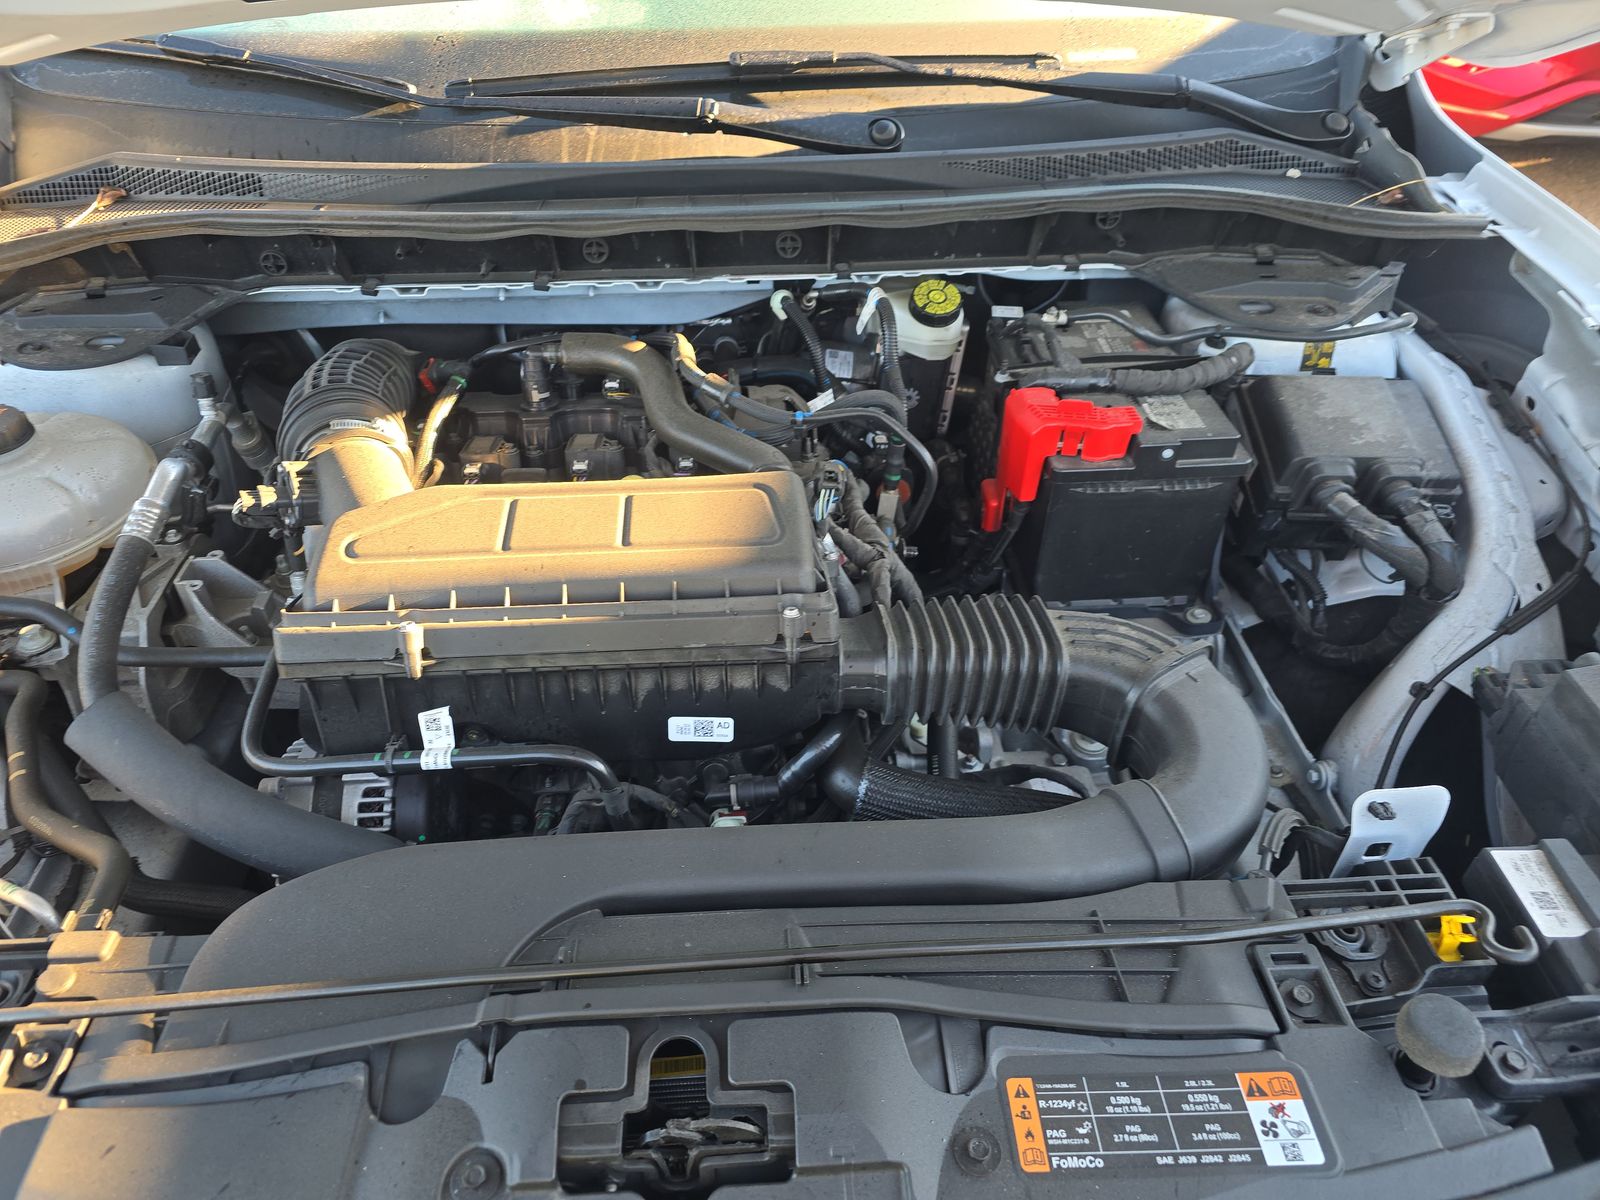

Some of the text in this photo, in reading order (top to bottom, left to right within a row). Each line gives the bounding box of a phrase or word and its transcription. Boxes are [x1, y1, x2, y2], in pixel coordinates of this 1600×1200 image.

[716, 721, 730, 730] AD
[1110, 1095, 1142, 1106] 0.500 kg
[1187, 1093, 1220, 1103] 0.550 kg
[1038, 1099, 1076, 1110] R-1234yf
[1125, 1124, 1142, 1133] PAG
[1204, 1123, 1222, 1131] PAG
[1046, 1129, 1067, 1138] PAG
[1051, 1156, 1104, 1168] FoMoCo
[1155, 1156, 1175, 1165] SAE
